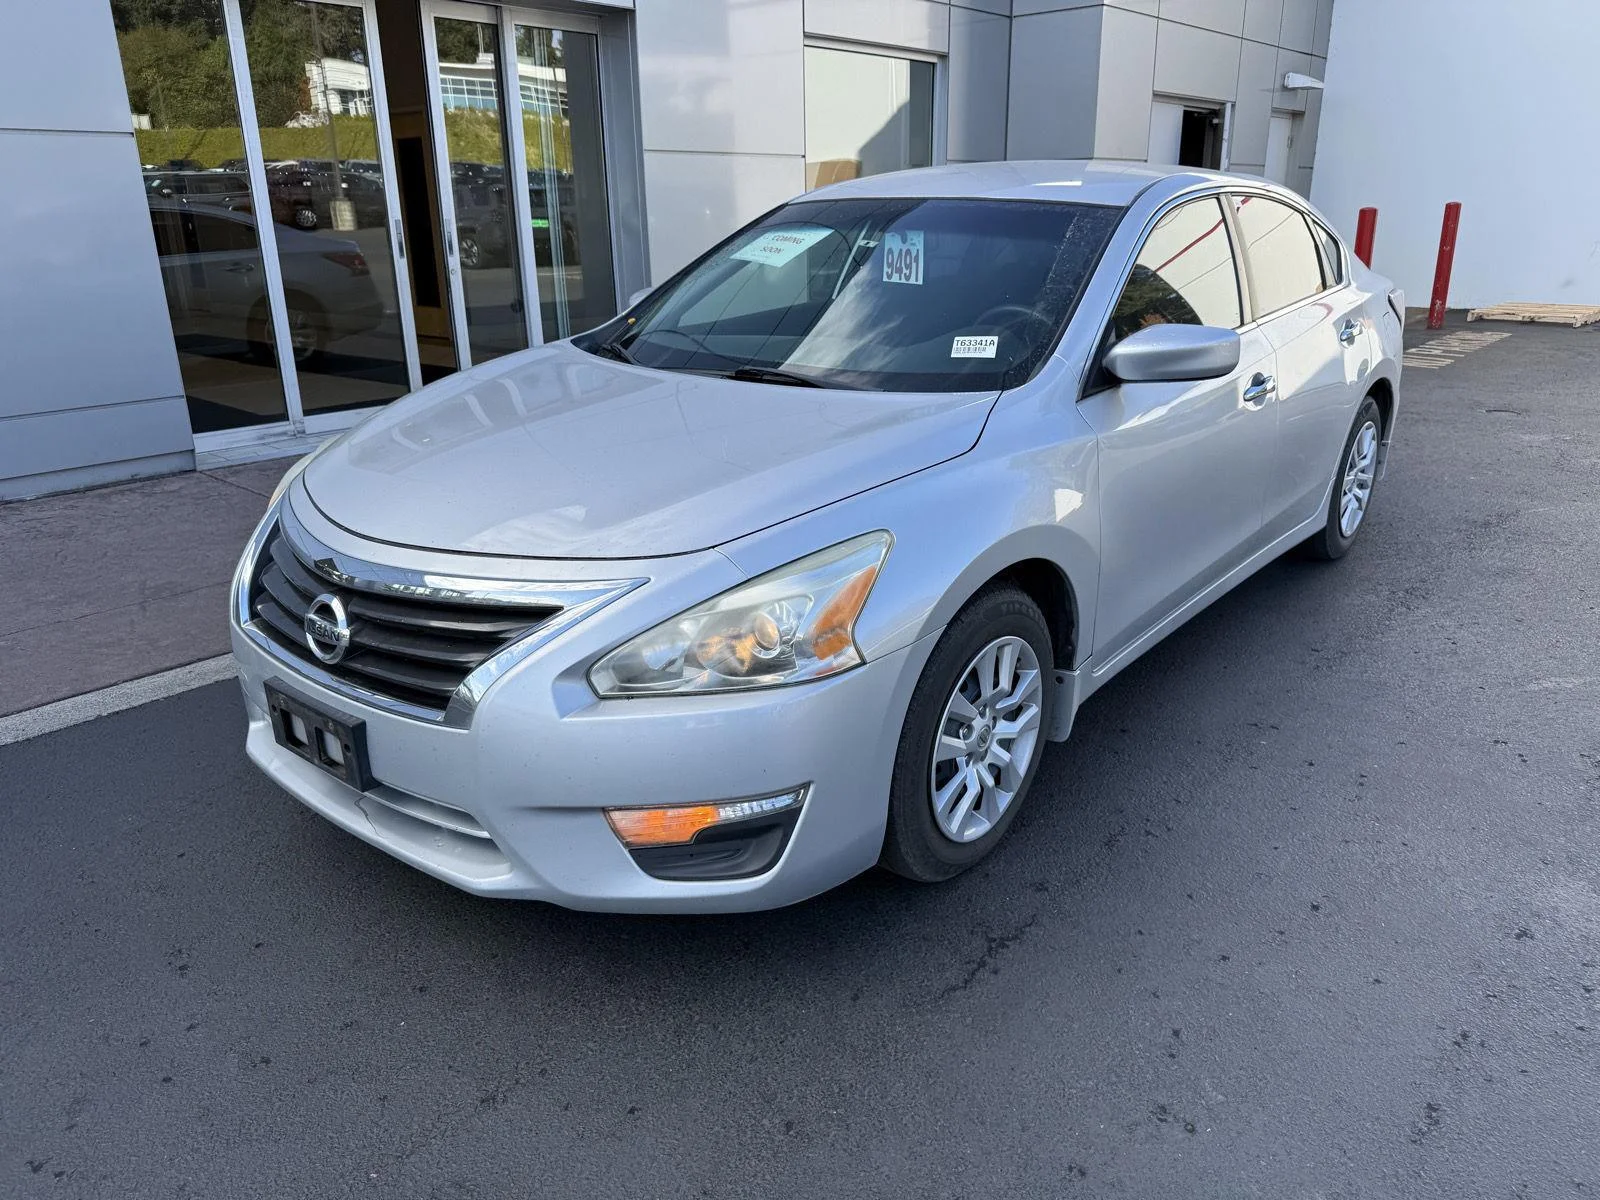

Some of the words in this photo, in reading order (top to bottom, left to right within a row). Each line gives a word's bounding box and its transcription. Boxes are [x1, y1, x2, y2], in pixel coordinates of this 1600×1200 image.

[771, 234, 805, 244] COMING
[760, 245, 784, 254] SOON
[886, 247, 920, 282] 9491
[955, 339, 995, 347] T63341A
